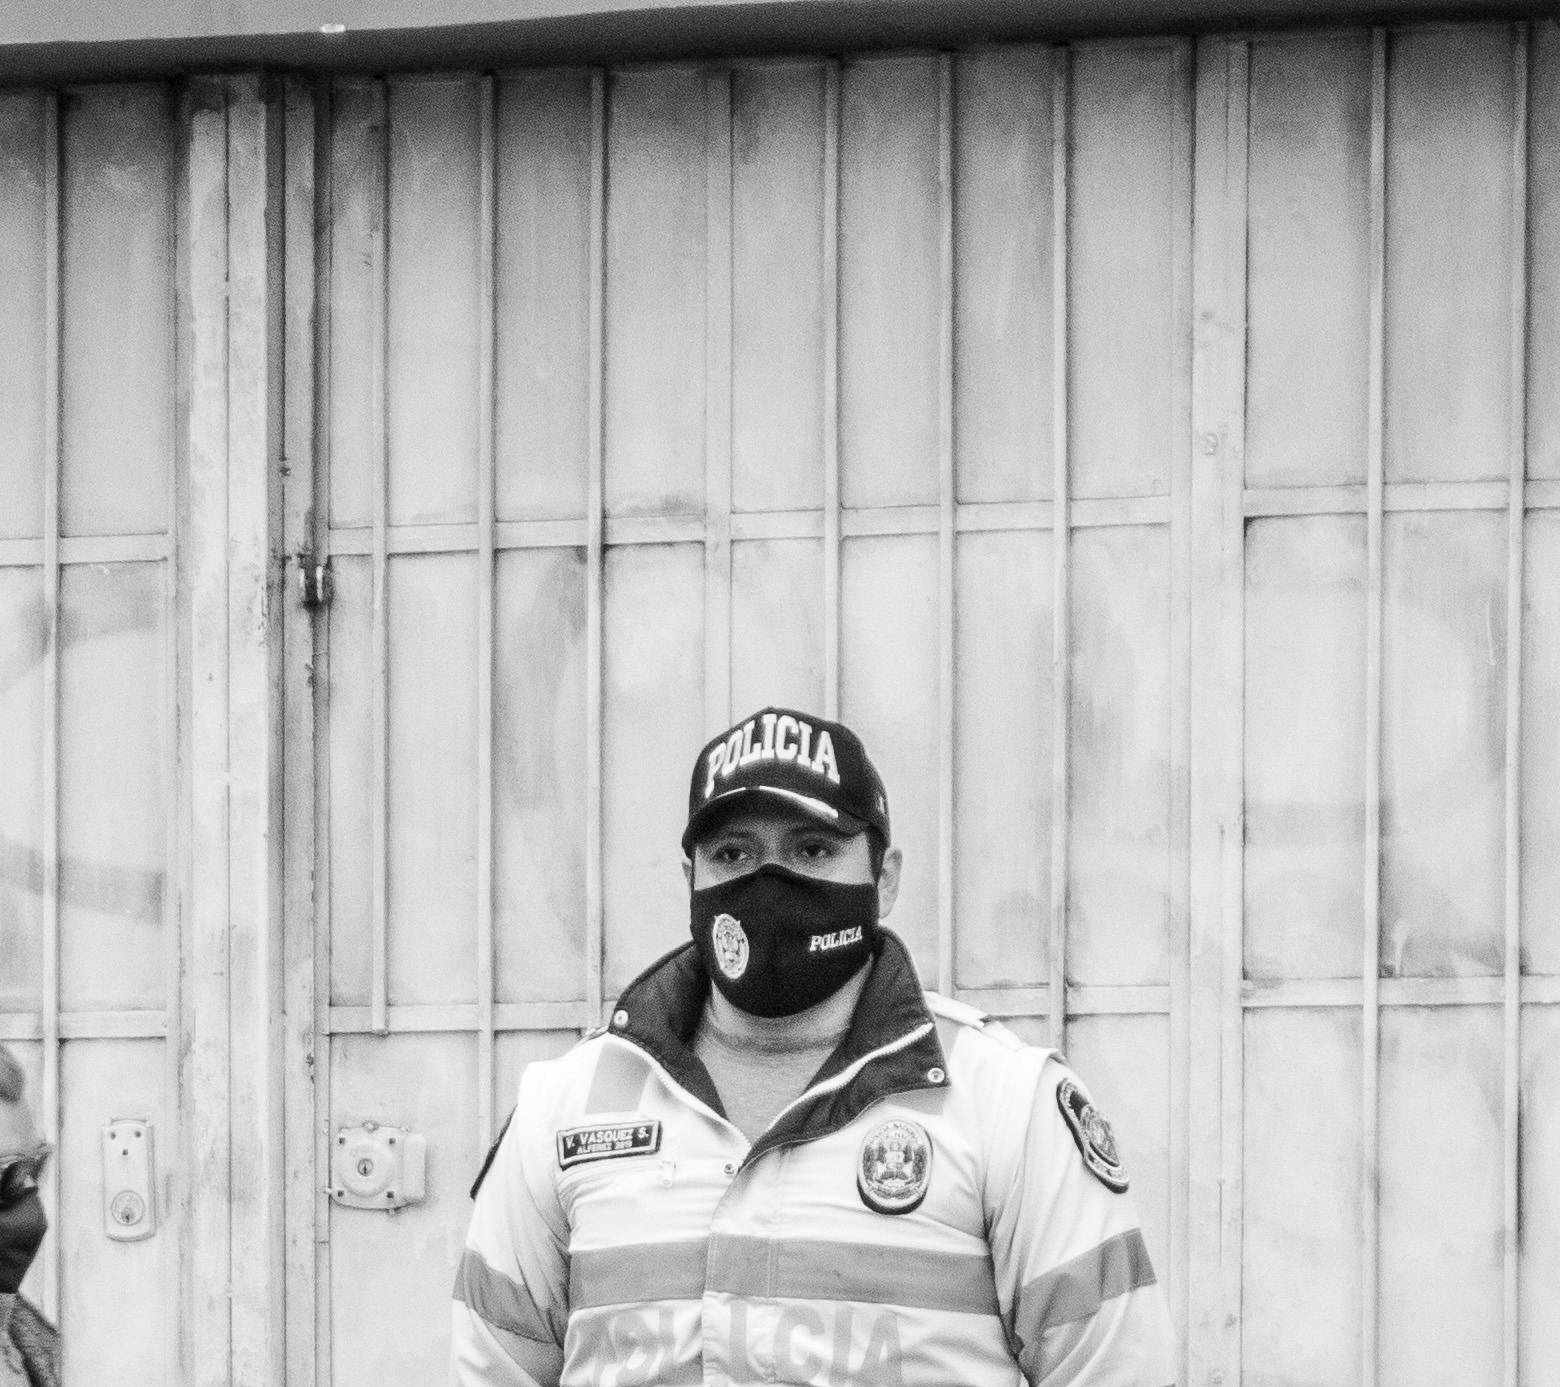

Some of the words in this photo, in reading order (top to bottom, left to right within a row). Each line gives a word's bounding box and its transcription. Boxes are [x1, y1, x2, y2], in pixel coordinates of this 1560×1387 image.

[705, 713, 840, 798] POLICIA
[809, 925, 863, 952] POLICIA
[580, 1129, 634, 1145] VASQUEZ
